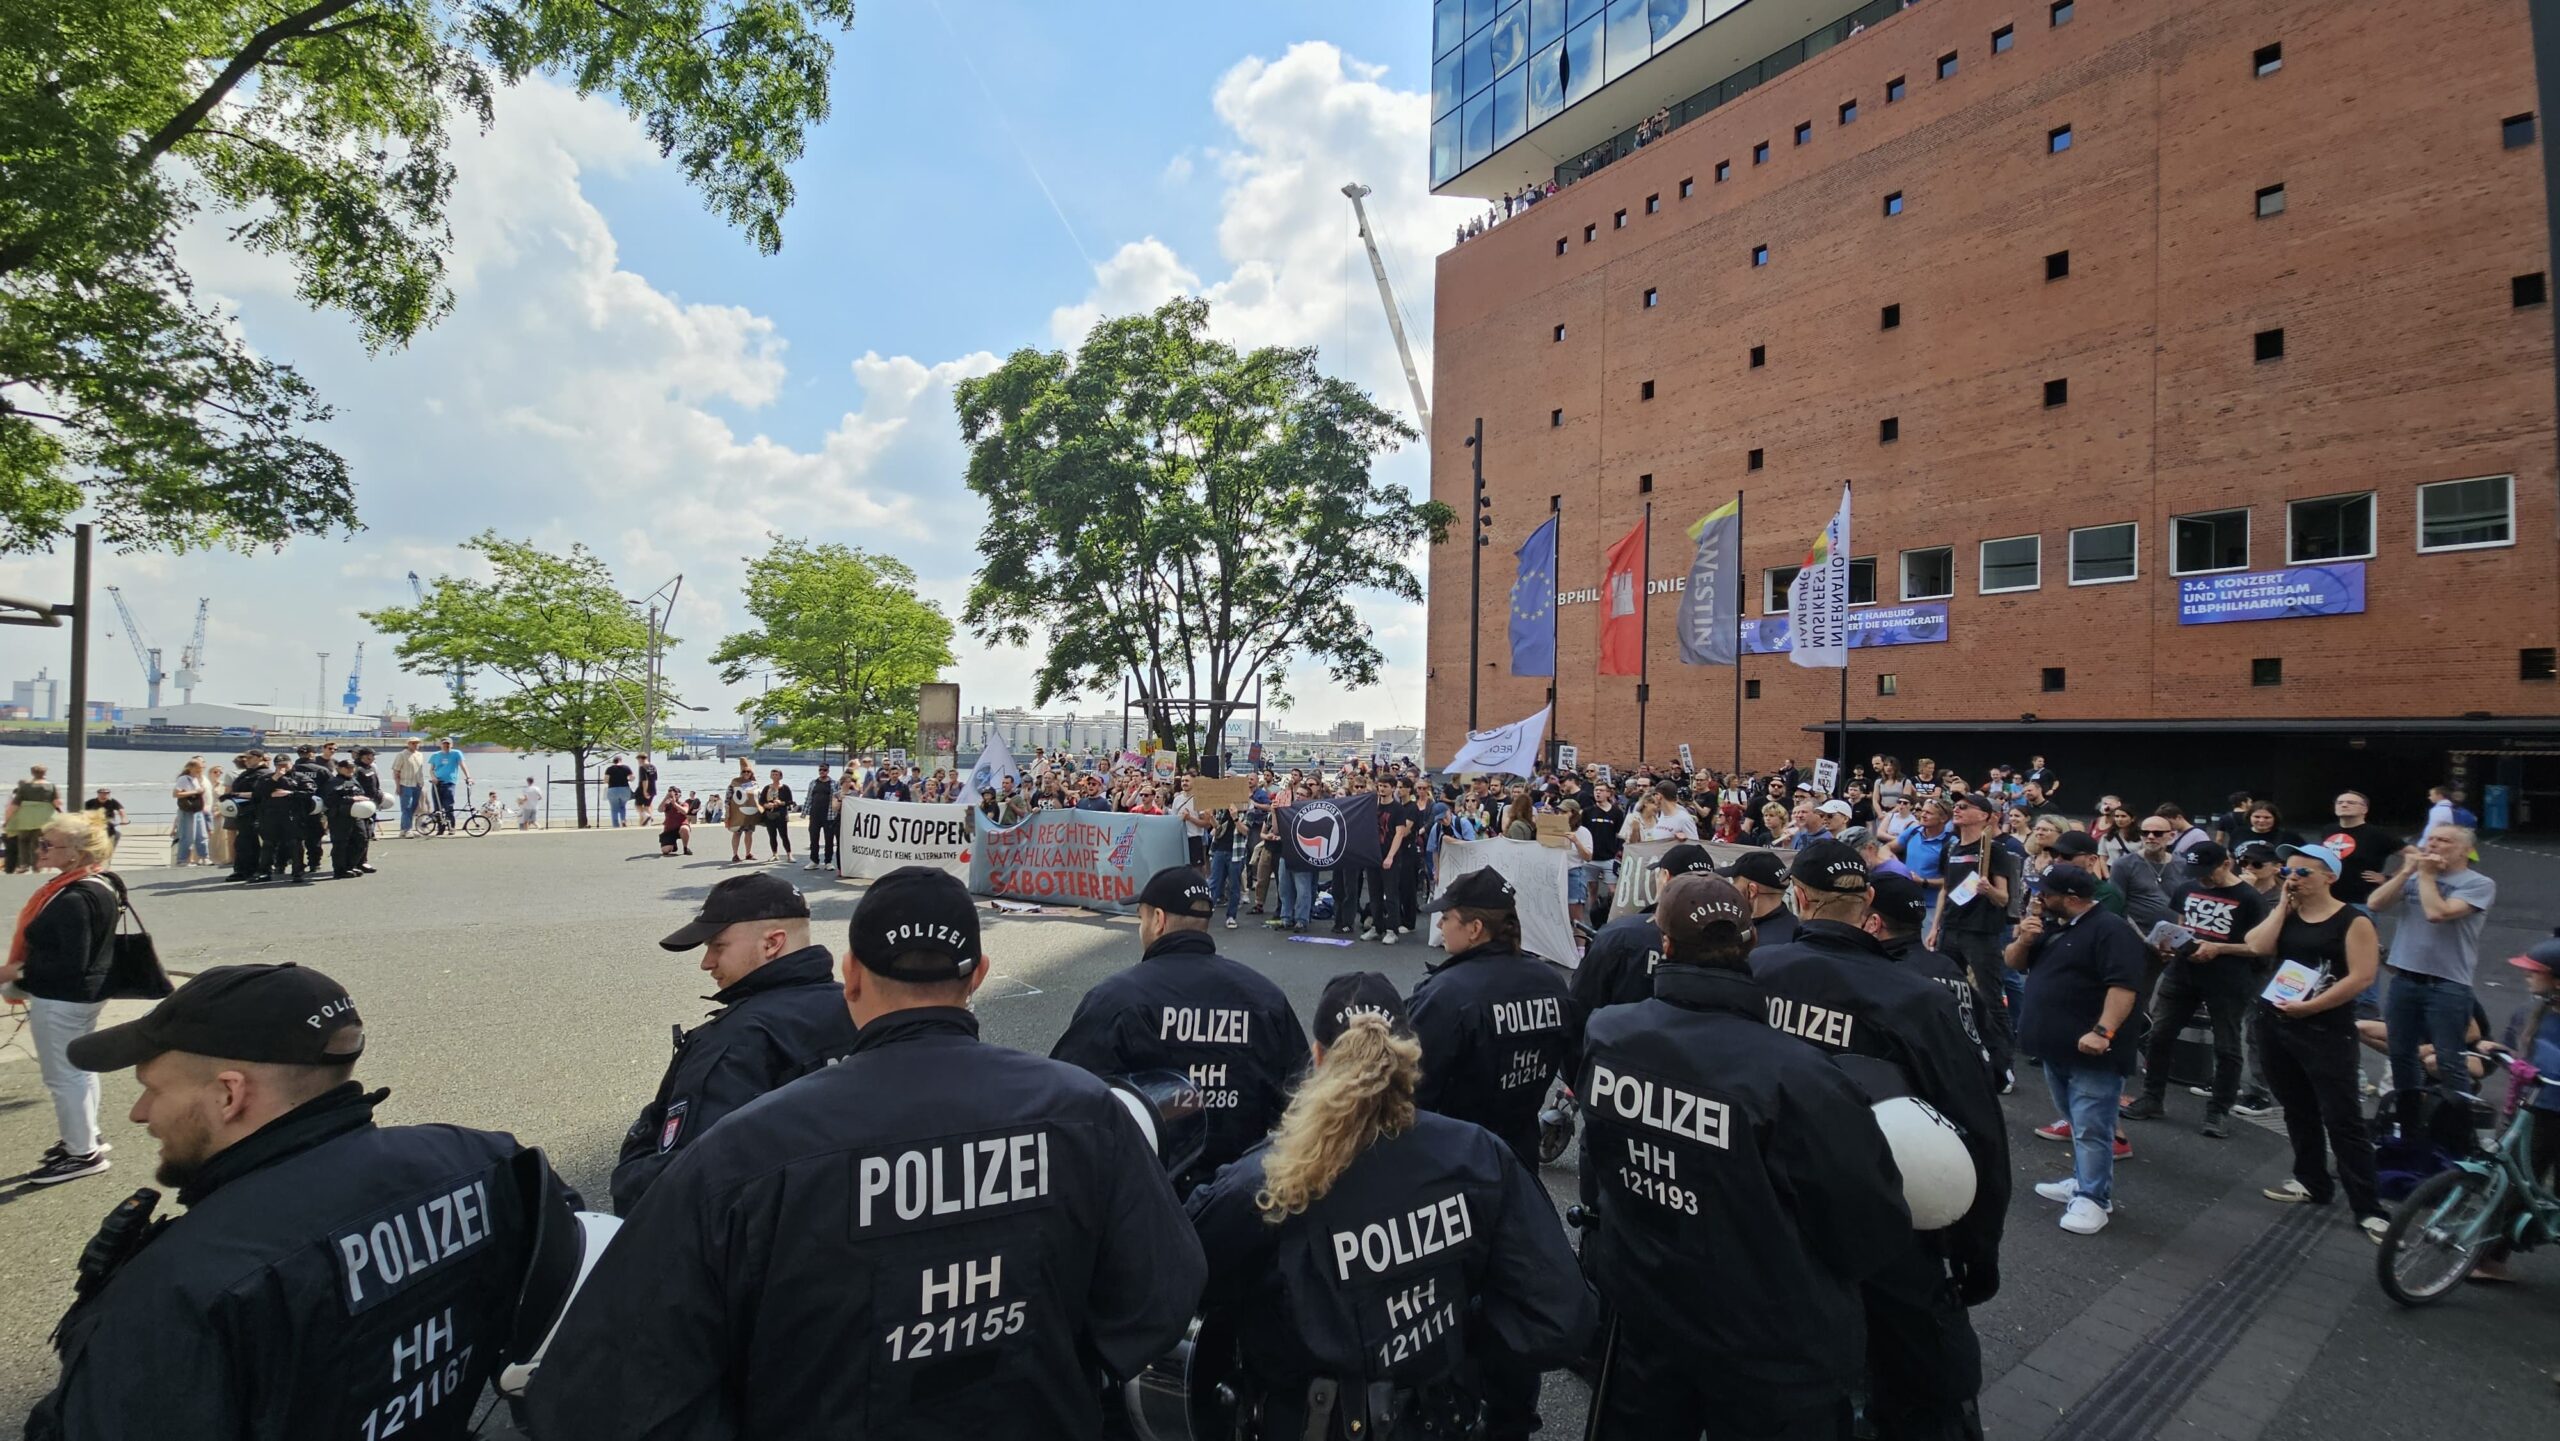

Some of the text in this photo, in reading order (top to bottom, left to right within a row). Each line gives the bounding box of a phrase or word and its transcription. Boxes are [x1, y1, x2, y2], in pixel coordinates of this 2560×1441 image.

[1693, 536, 1720, 646] WESTIN
[2184, 574, 2284, 591] 3.6. KONZERT
[2184, 584, 2311, 603] UND LIVESTREAM
[1848, 608, 1916, 622] ANZ HAMBURG
[2184, 595, 2324, 615] ELBPHILHARMONIE
[1848, 615, 1945, 631] ERT DIE DEMOKRATIE
[1298, 803, 1340, 818] ANTIFASCIST
[852, 812, 972, 845] AfD STOPPEN
[987, 822, 1112, 847] DEN RECHTEN
[883, 849, 893, 859] IST
[895, 850, 912, 861] KEINE
[914, 851, 958, 863] ALTERNATIVE
[987, 849, 1100, 870] WAHLKAMPF
[1308, 856, 1335, 865] ACTION
[989, 870, 1134, 900] SABOTIEREN
[1689, 901, 1743, 923] POLIZEI
[2184, 896, 2238, 921] FCK
[886, 923, 966, 949] POLIZEI
[2184, 913, 2232, 935] NZS
[1160, 1006, 1250, 1044] POLIZEI
[1493, 997, 1562, 1035] POLIZEI
[1765, 995, 1853, 1048] OLIZEI
[1513, 1049, 1541, 1069] HH
[1188, 1063, 1227, 1087] HH
[1501, 1064, 1547, 1090] 121214
[1171, 1088, 1239, 1109] 121286
[1590, 1064, 1730, 1150] POLIZEI
[1627, 1138, 1676, 1180] HH
[859, 1131, 1049, 1228] POLIZEI
[1619, 1167, 1699, 1216] 121193
[338, 1180, 492, 1303] POLIZEI
[1333, 1192, 1472, 1280] POLIZEI
[921, 1256, 1002, 1316] HH
[1386, 1278, 1436, 1329] HH
[392, 1307, 453, 1383] HH
[885, 1301, 1028, 1362] 121155
[1379, 1303, 1456, 1367] 121111
[361, 1344, 473, 1441] 121167
